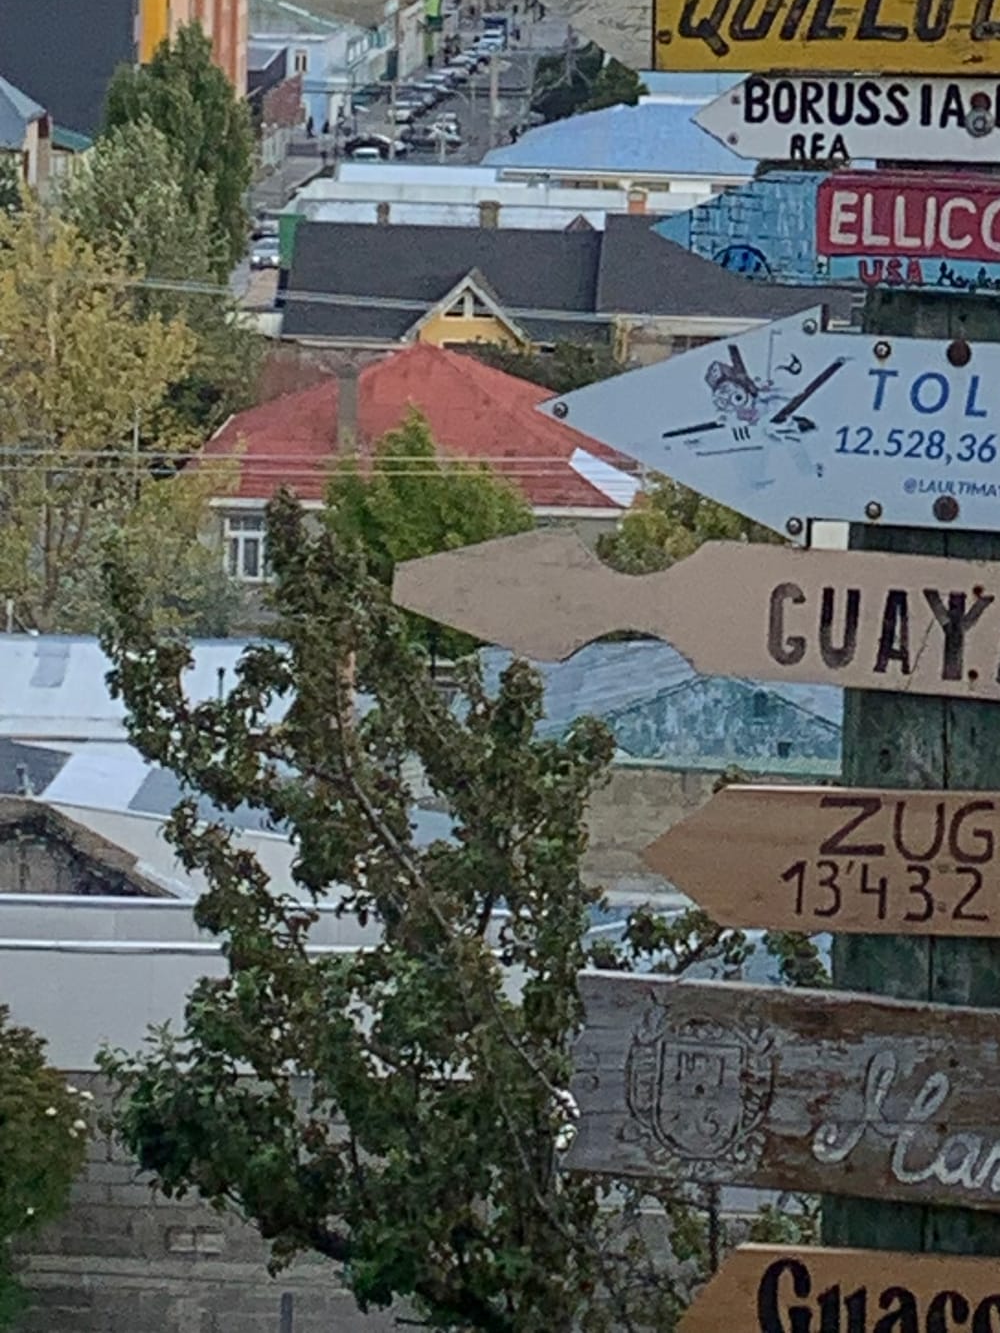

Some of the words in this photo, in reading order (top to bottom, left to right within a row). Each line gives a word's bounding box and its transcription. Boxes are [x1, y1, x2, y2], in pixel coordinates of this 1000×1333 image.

[743, 77, 967, 129] BORUSSIA
[790, 132, 850, 161] RFA
[858, 257, 924, 287] USA
[834, 425, 998, 466] 12.528,36
[819, 795, 995, 865] ZUG
[780, 860, 989, 922] 13'432
